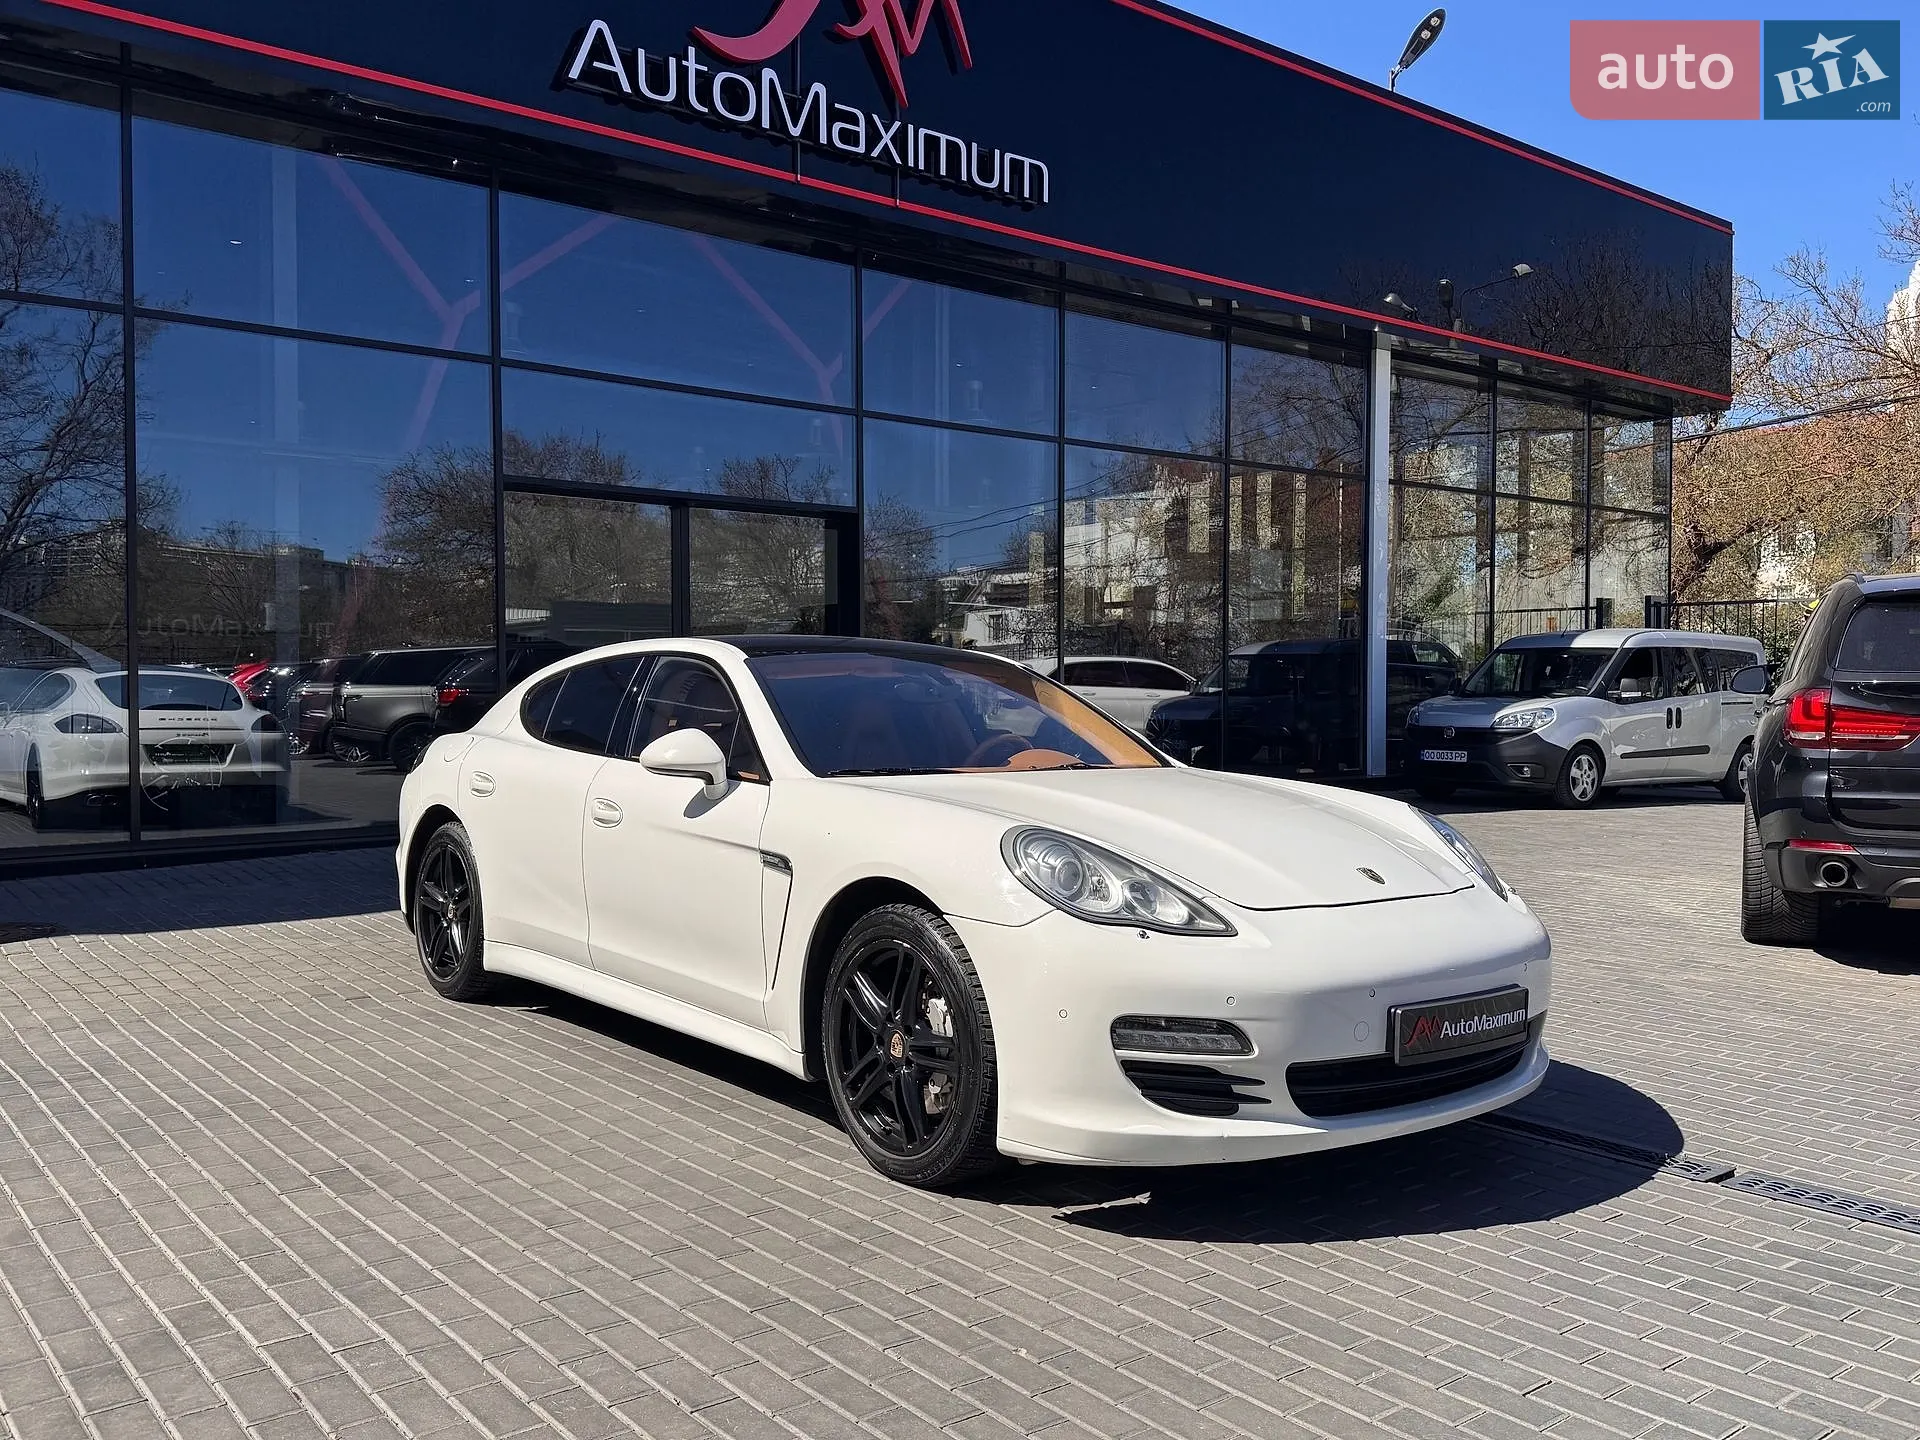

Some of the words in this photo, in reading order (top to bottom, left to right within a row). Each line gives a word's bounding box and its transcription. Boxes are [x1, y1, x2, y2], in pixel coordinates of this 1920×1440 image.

[568, 19, 1049, 203] AutoMaximum
[1435, 751, 1454, 761] 0033
[1440, 1008, 1526, 1039] AutoMaximum
